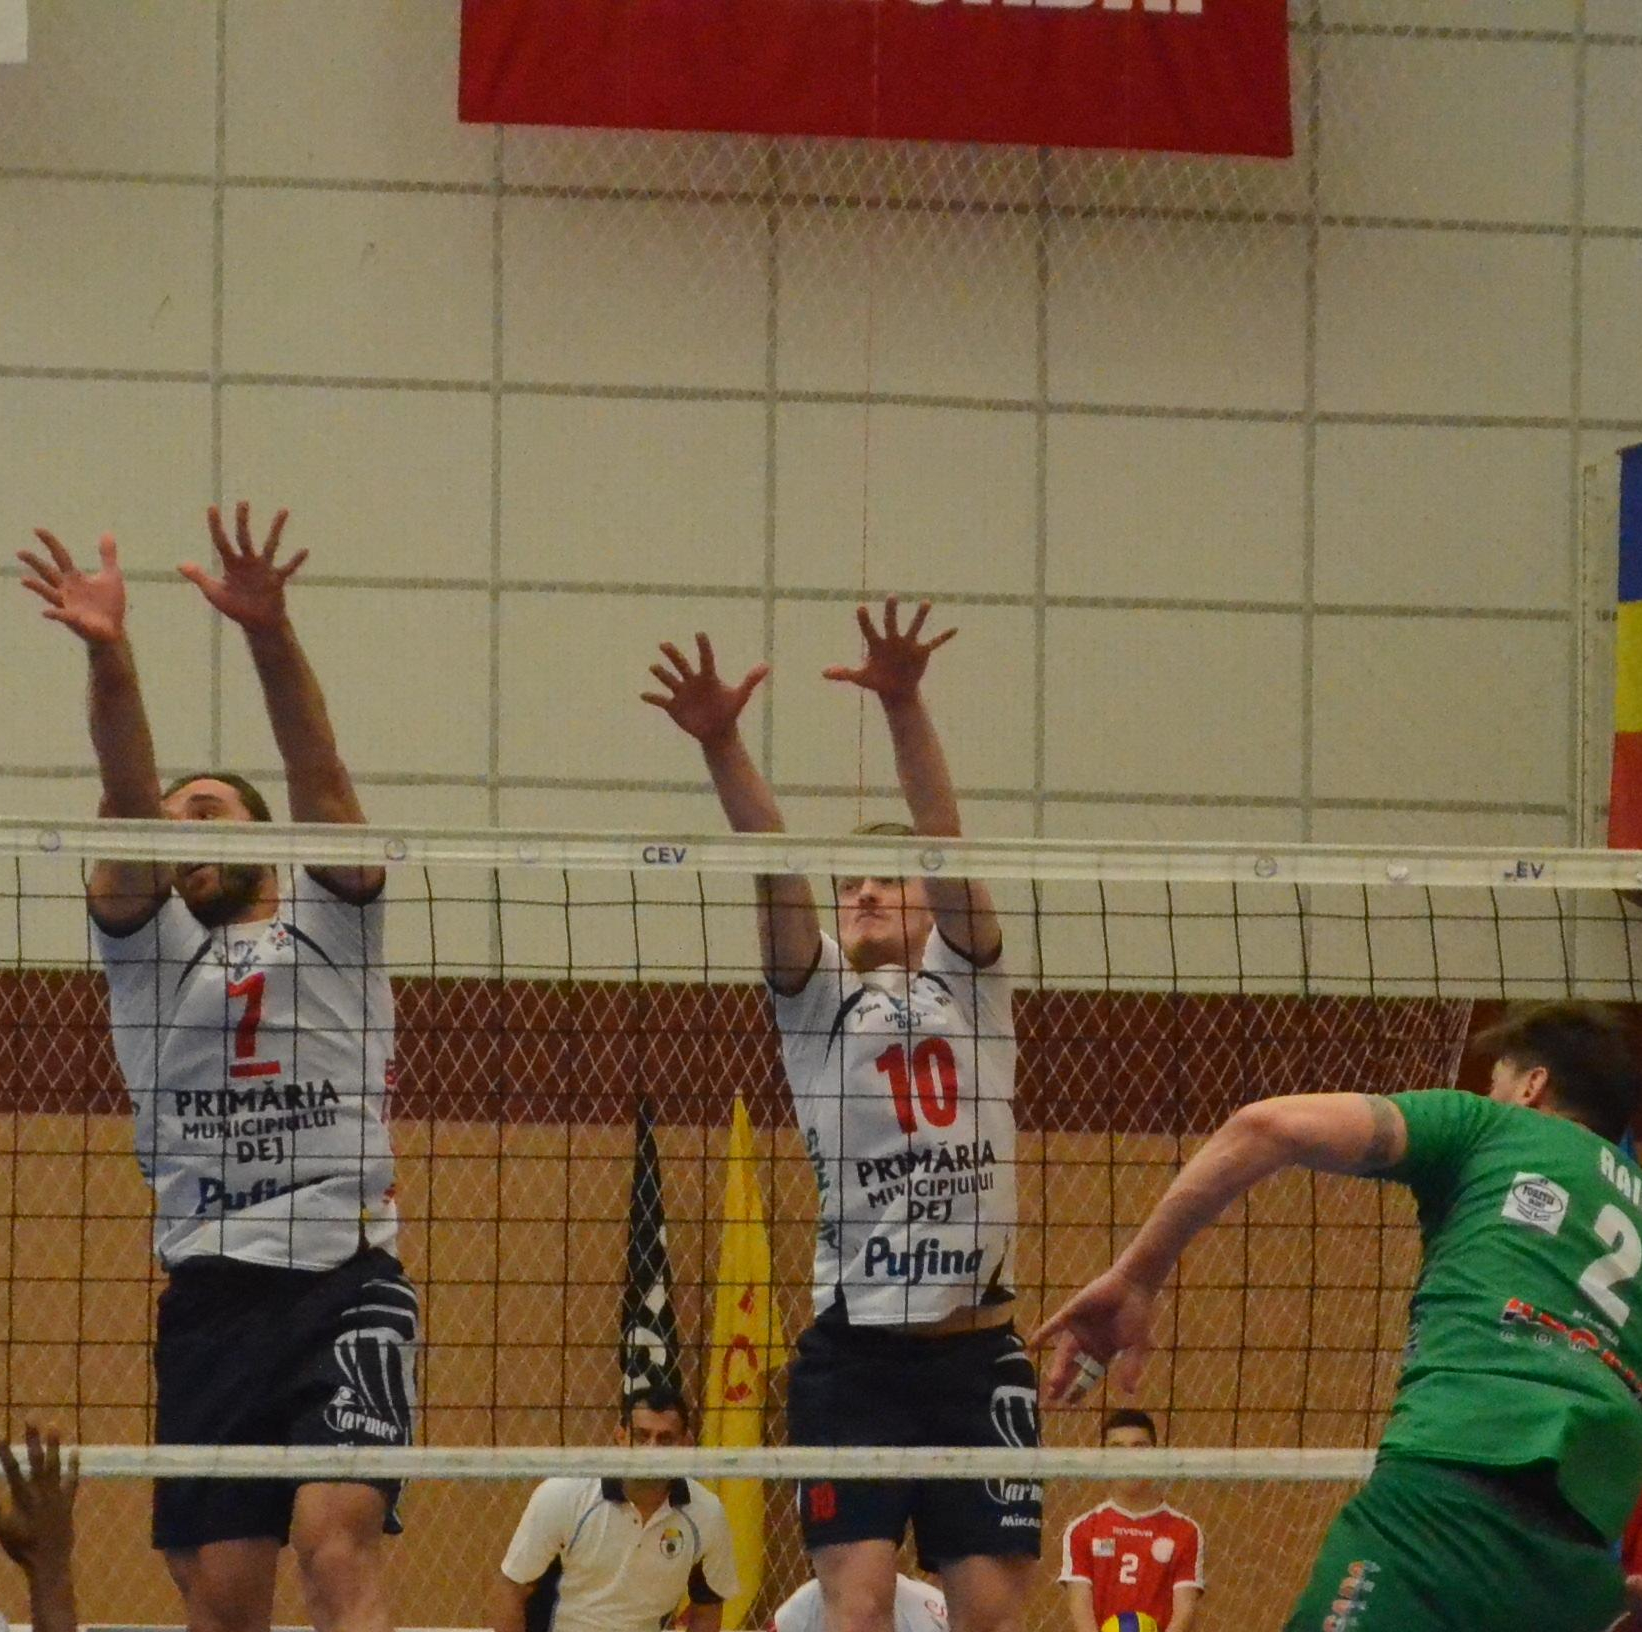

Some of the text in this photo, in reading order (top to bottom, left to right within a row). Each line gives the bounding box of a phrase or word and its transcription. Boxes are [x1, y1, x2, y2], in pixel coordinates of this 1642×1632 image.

[641, 845, 686, 864] CEV
[227, 971, 267, 1060] 7
[175, 1080, 341, 1117] PRIMĂRIA
[875, 1036, 958, 1135] 10
[182, 1108, 338, 1141] MUNICIPIULUI
[236, 1135, 285, 1165] DEJ
[857, 1139, 997, 1188] PRIMĂRIA
[909, 1199, 954, 1222] DEJ
[864, 1235, 983, 1286] Pufina
[1579, 1203, 1642, 1327] 2
[1119, 1553, 1139, 1585] 2
